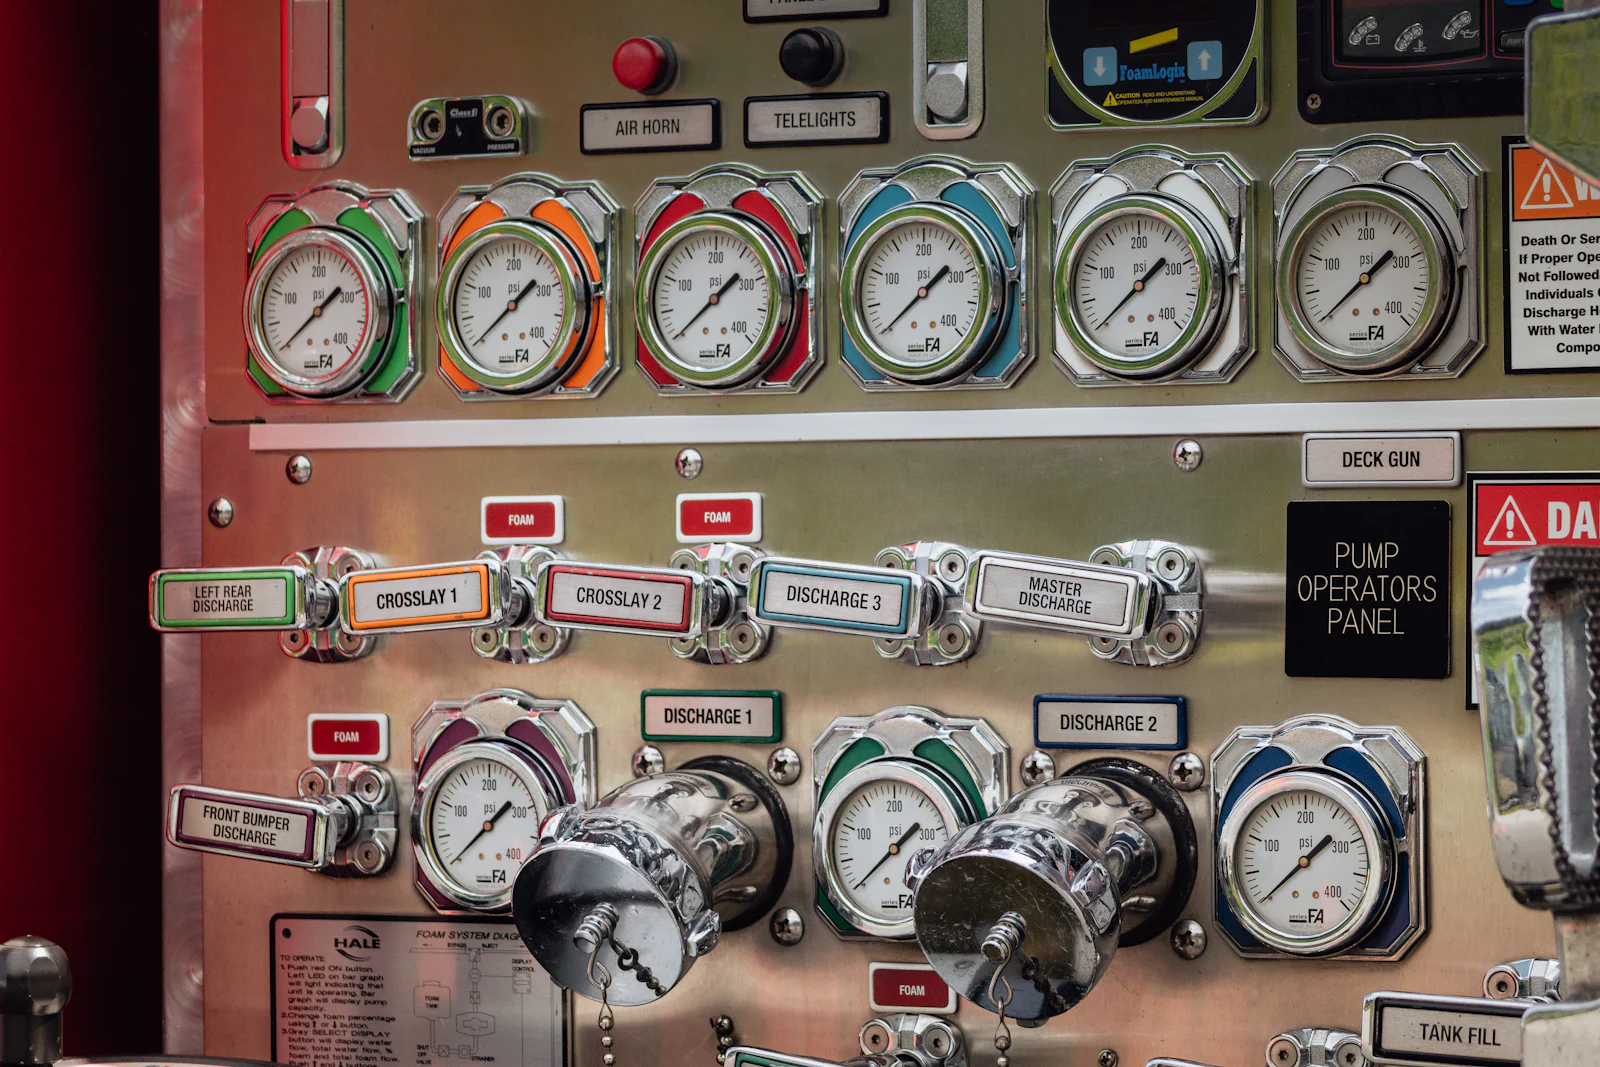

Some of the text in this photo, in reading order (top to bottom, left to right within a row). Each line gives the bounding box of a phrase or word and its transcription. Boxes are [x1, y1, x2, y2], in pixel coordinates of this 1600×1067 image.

[1120, 62, 1185, 83] FoamLogix
[774, 111, 856, 128] TELELIGHTS
[616, 119, 680, 136] AIR HORN
[1358, 228, 1374, 240] 200
[1521, 235, 1557, 246] Death
[1561, 234, 1576, 244] Or
[1131, 236, 1147, 249] 200
[916, 244, 931, 256] 200
[708, 252, 723, 263] 200
[1360, 252, 1373, 267] psi
[1393, 256, 1409, 268] 300
[1519, 254, 1527, 264] If
[1531, 253, 1573, 268] Proper
[507, 259, 521, 270] 200
[1134, 260, 1146, 275] psi
[1166, 263, 1181, 275] 300
[1325, 258, 1339, 270] 100
[312, 266, 326, 278] 200
[918, 267, 930, 281] psi
[948, 271, 963, 283] 300
[1100, 267, 1114, 279] 100
[1519, 270, 1599, 282] Not Followed
[710, 275, 722, 288] psi
[739, 279, 754, 290] 300
[885, 273, 899, 284] 100
[508, 281, 520, 295] psi
[537, 285, 551, 296] 300
[678, 280, 691, 291] 100
[313, 288, 324, 300] psi
[340, 292, 354, 303] 300
[478, 286, 491, 298] 100
[1526, 288, 1593, 300] Individuals
[284, 293, 297, 304] 100
[1385, 301, 1401, 313] 400
[1524, 307, 1586, 319] Discharge
[1159, 307, 1175, 320] 400
[941, 314, 956, 326] 400
[530, 327, 544, 338] 400
[731, 321, 746, 333] 400
[1369, 326, 1384, 340] FA
[1528, 324, 1594, 335] With Water
[333, 333, 347, 344] 400
[926, 338, 939, 351] FA
[1143, 332, 1158, 346] FA
[515, 349, 528, 362] FA
[717, 344, 730, 357] FA
[320, 355, 332, 368] FA
[1342, 451, 1420, 468] DECK GUN
[508, 514, 534, 526] FOAM
[704, 511, 731, 523] FOAM
[1547, 501, 1600, 539] DA
[1335, 542, 1399, 569] PUMP
[195, 585, 252, 599] LEFT REAR
[1028, 576, 1082, 597] MASTER
[1298, 575, 1437, 602] OPERATORS
[376, 588, 457, 610] CROSSLAY 1
[576, 587, 662, 610] CROSSLAY 2
[787, 585, 882, 611] DISCHARGE 3
[1019, 591, 1092, 615] DISCHARGE
[193, 598, 254, 613] DISCHARGE
[1328, 608, 1404, 635] PANEL
[664, 708, 752, 725] DISCHARGE 1
[1059, 714, 1158, 732] DISCHARGE 2
[334, 732, 359, 742] FOAM
[482, 779, 496, 791] 200
[454, 806, 467, 817] 100
[484, 802, 495, 815] psi
[887, 800, 902, 812] 200
[203, 805, 289, 831] FRONT BUMPER
[512, 807, 526, 818] 300
[1297, 811, 1313, 824] 200
[213, 824, 277, 846] DISCHARGE
[857, 828, 870, 840] 100
[889, 824, 901, 838] psi
[920, 828, 934, 840] 300
[1264, 839, 1279, 852] 100
[1300, 836, 1312, 850] psi
[1332, 841, 1349, 853] 300
[506, 848, 520, 860] 400
[493, 870, 505, 883] FA
[1324, 886, 1341, 898] 400
[899, 895, 913, 908] FA
[1308, 909, 1323, 924] FA
[449, 931, 489, 940] SYSTEM
[334, 938, 380, 949] HALE
[899, 985, 925, 996] FOAM
[1420, 1023, 1501, 1046] TANK FILL
[335, 1038, 363, 1046] display
